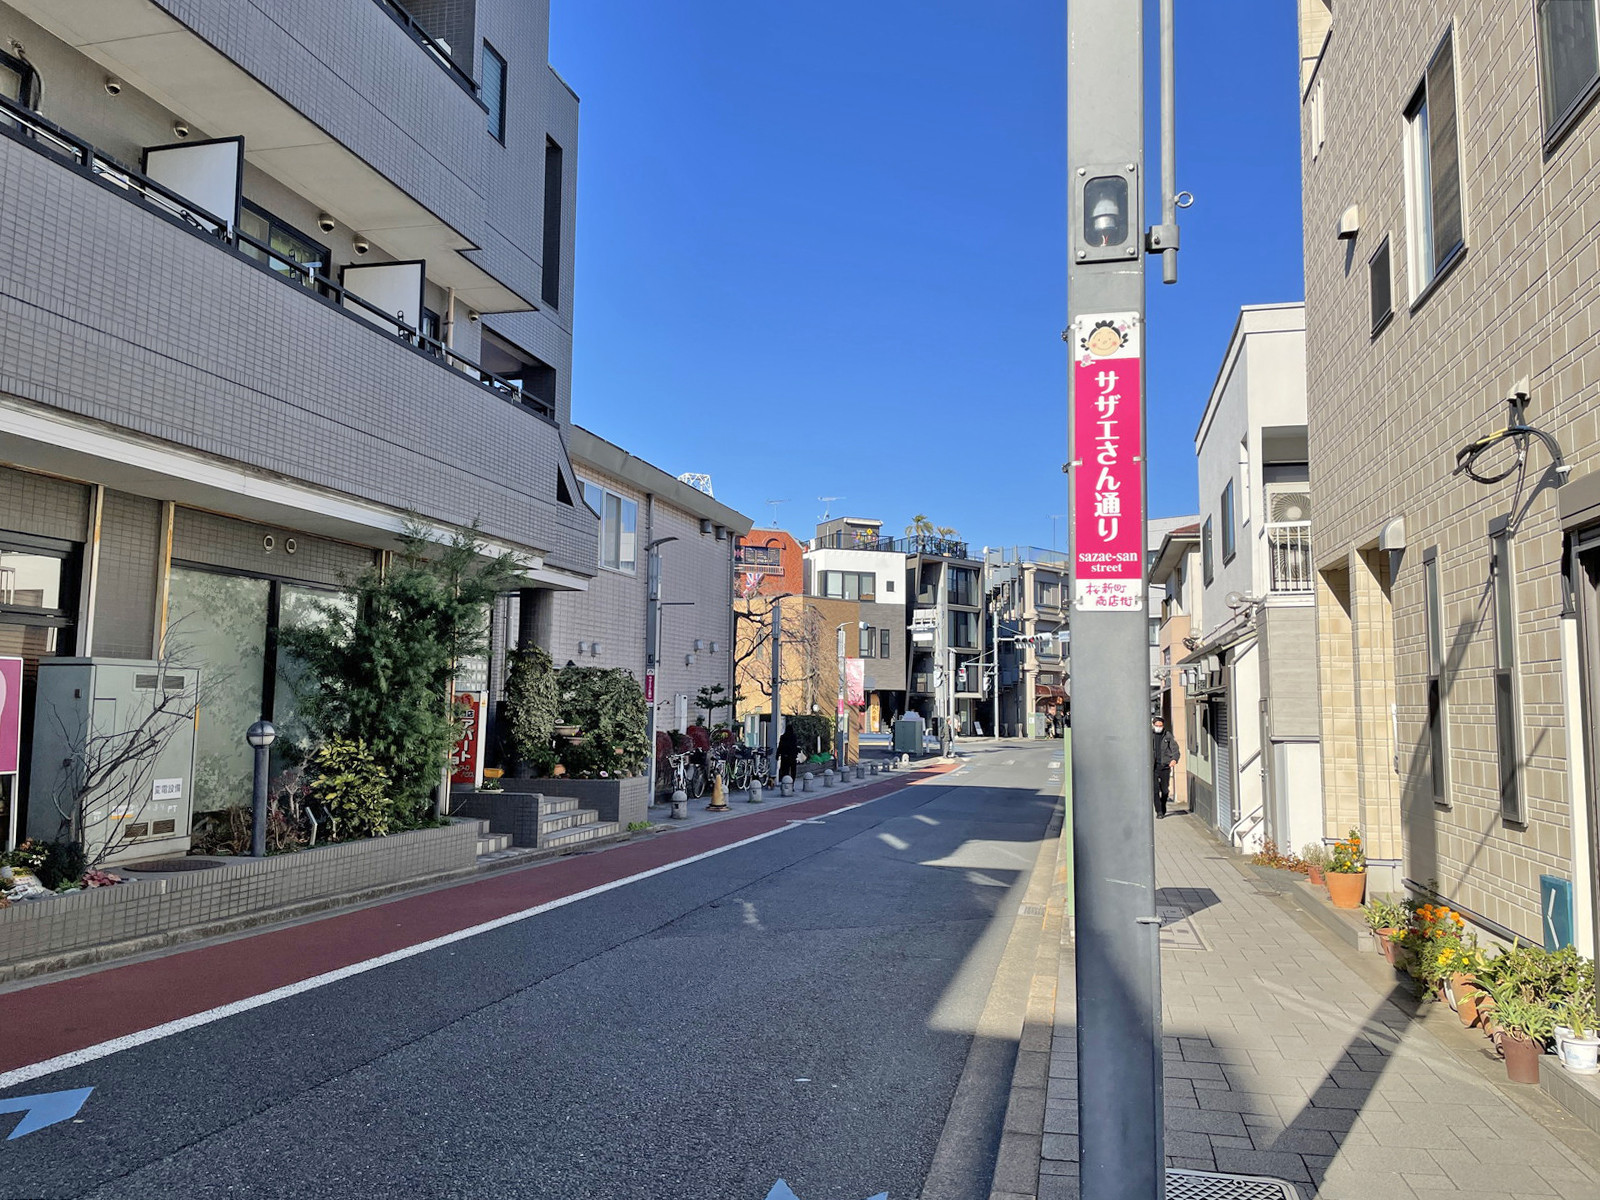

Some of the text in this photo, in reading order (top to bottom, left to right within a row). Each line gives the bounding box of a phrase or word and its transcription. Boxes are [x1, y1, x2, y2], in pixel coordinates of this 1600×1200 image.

[1094, 370, 1122, 543] サザエさん通り
[1078, 552, 1138, 562] sazae-san
[1091, 563, 1122, 572] street
[1096, 595, 1133, 607] 商店街
[460, 719, 475, 762] アパート
